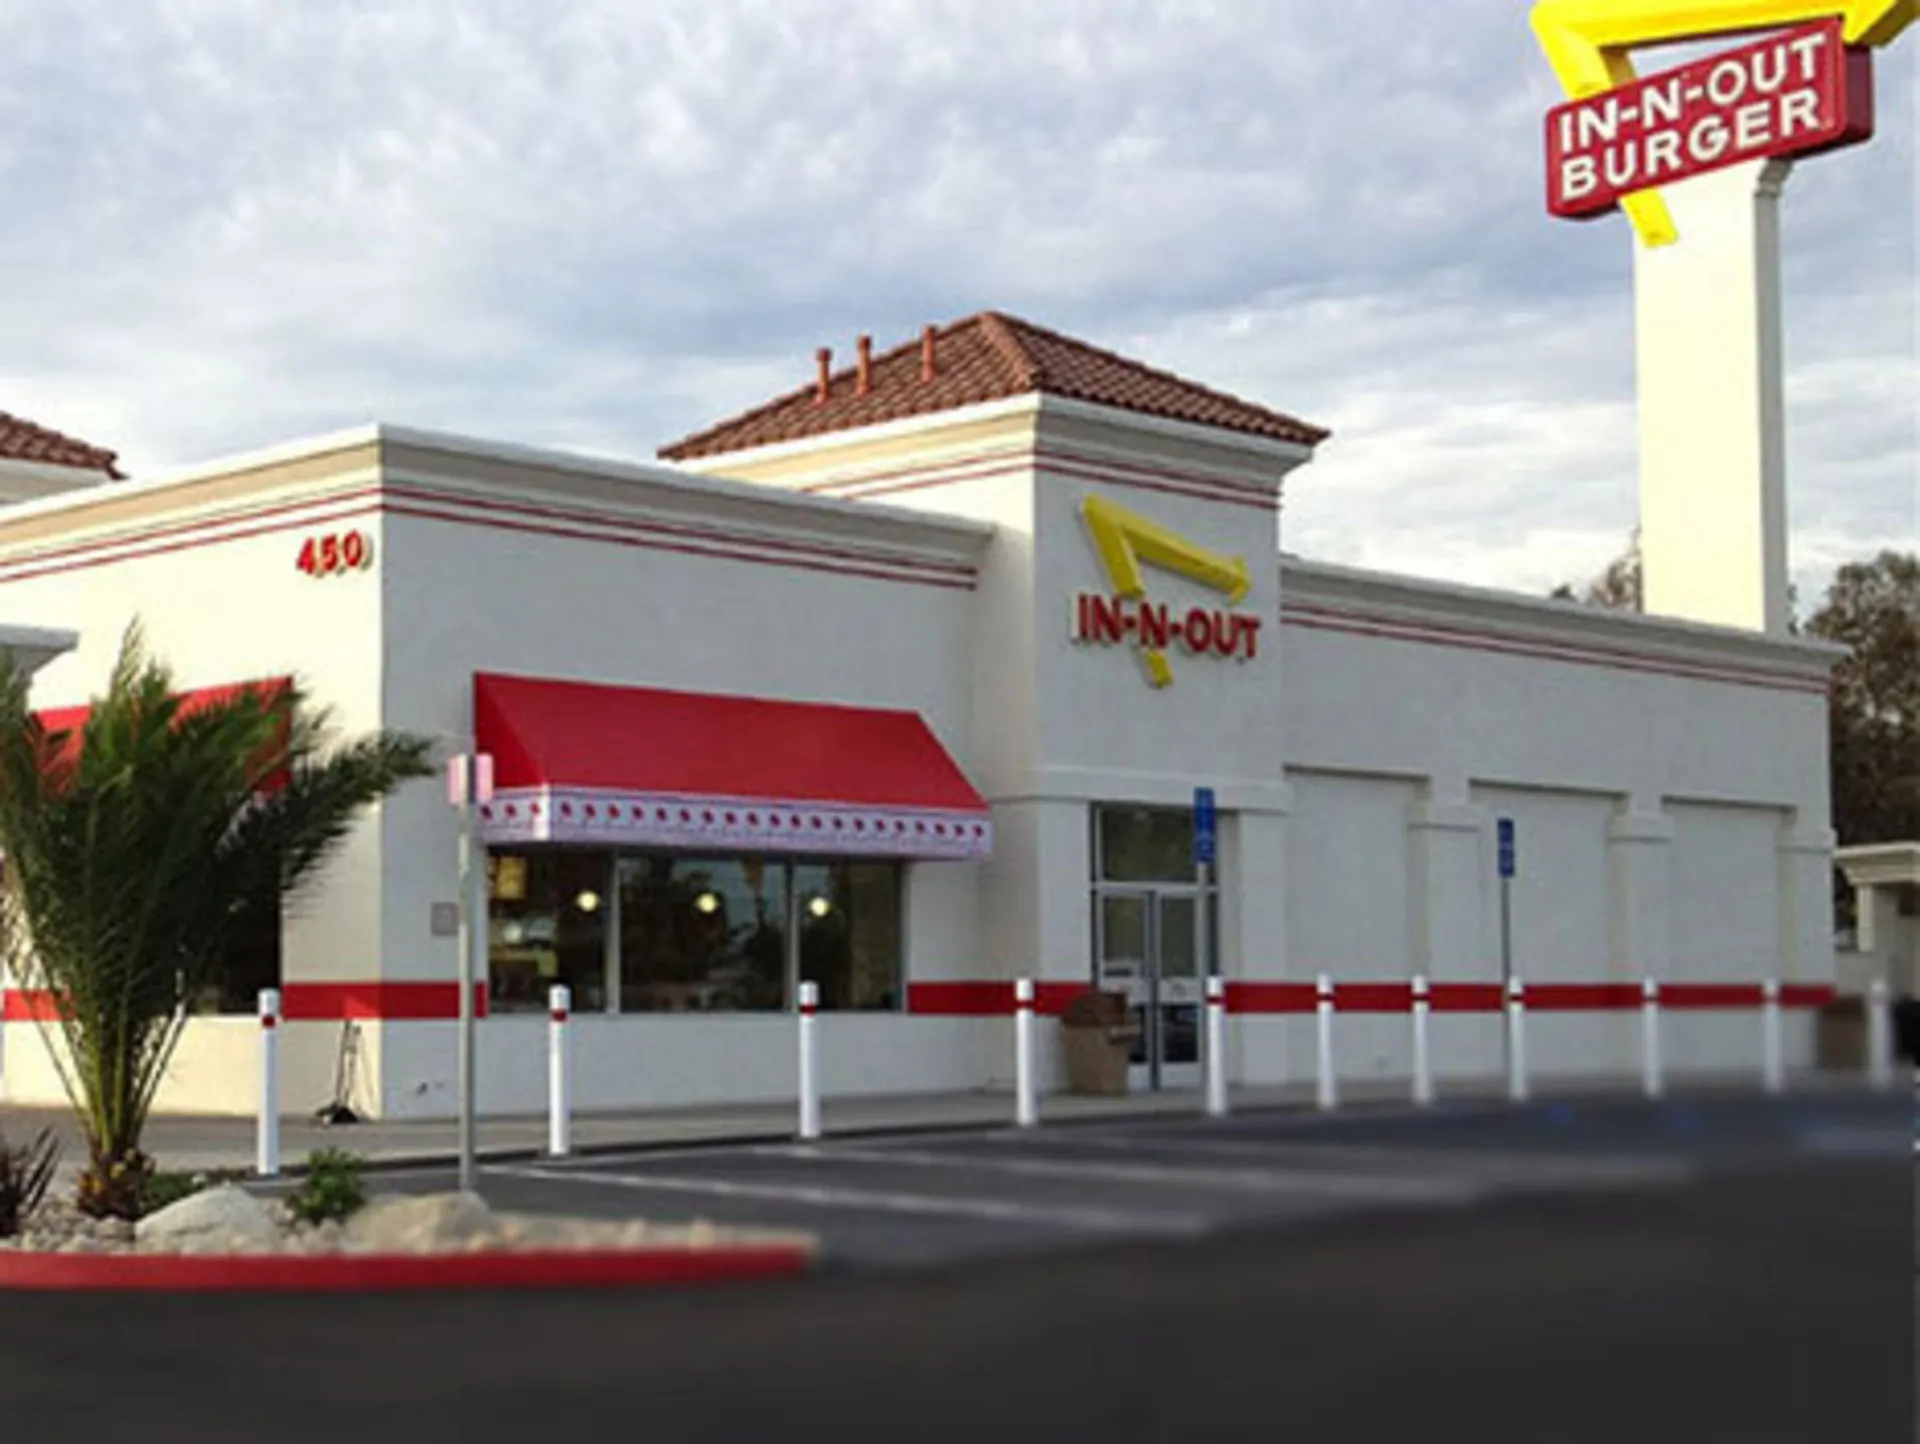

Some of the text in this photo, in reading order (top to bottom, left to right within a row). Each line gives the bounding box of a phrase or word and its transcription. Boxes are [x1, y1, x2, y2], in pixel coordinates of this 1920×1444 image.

[1559, 32, 1826, 153] IN-N-OUT
[1561, 89, 1822, 200] BURGER
[295, 529, 364, 575] 450
[1076, 592, 1262, 659] IN-N-OUT
